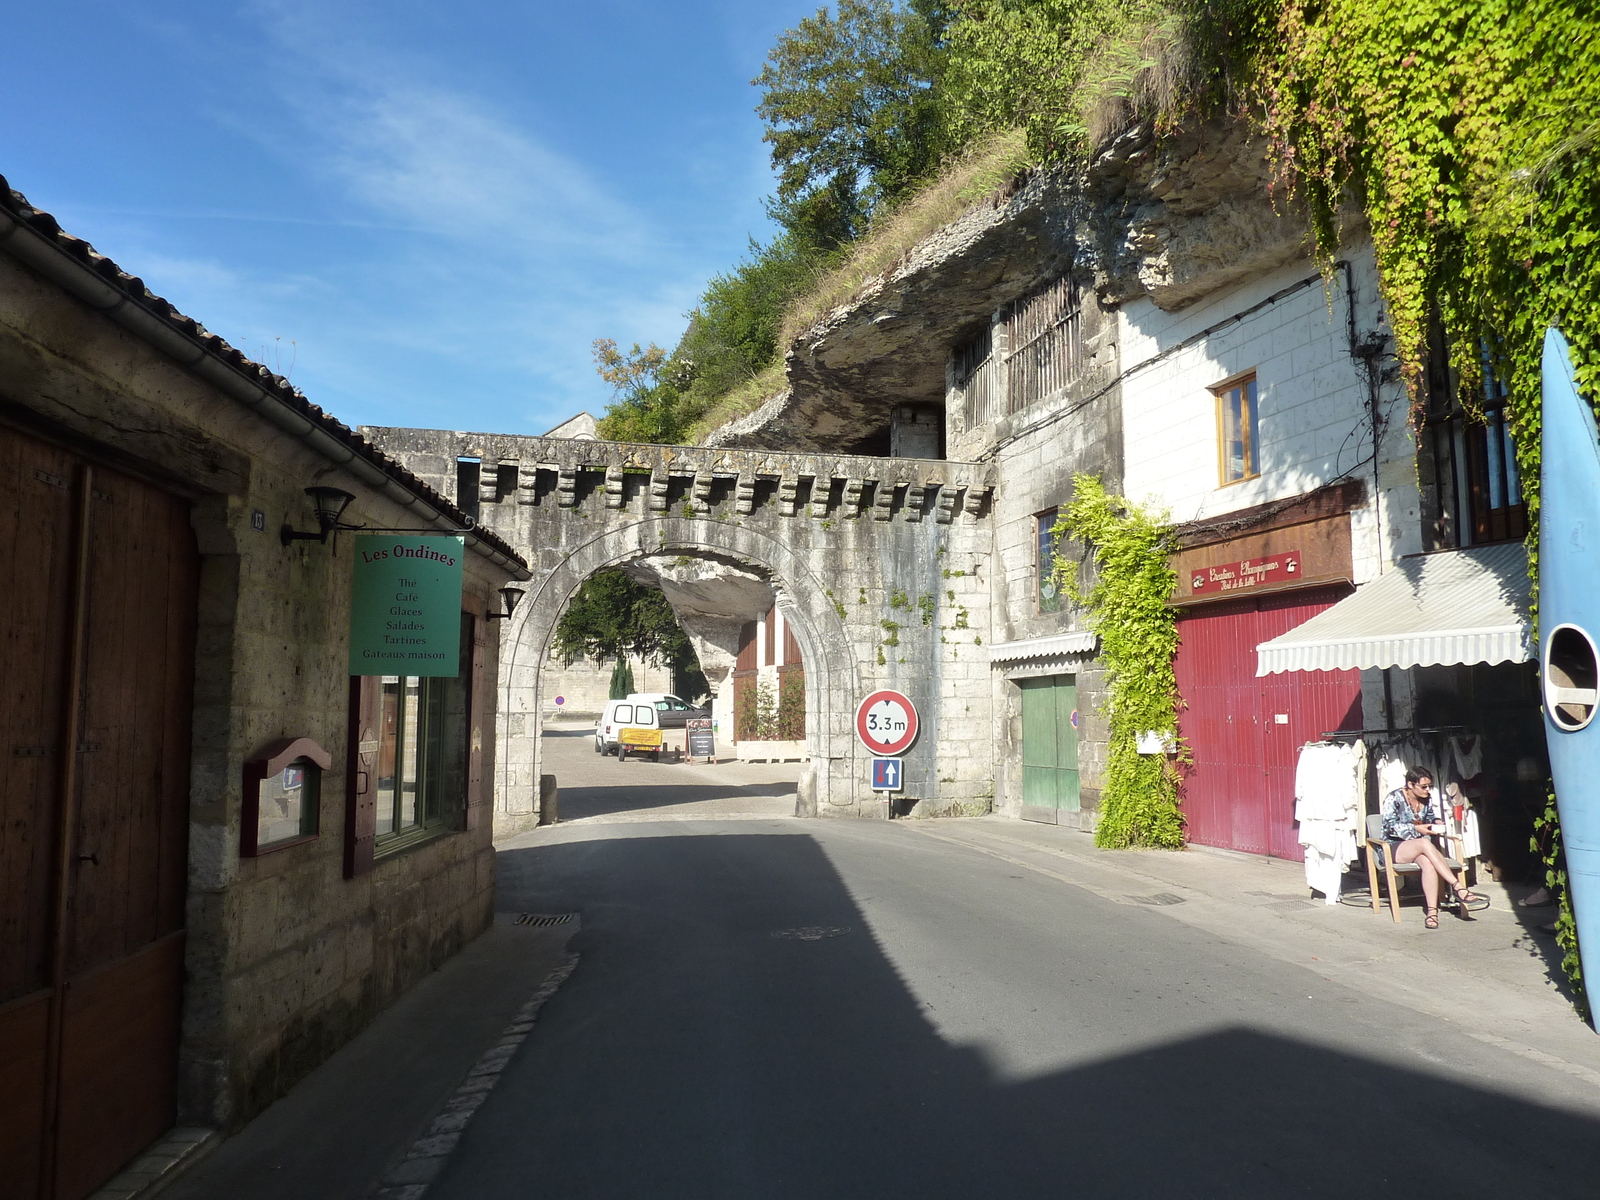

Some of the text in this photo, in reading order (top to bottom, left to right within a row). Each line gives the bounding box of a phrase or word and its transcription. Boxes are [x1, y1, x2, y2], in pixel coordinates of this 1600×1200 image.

[362, 544, 456, 567] Les Ondines
[389, 606, 423, 616] Glaces
[386, 621, 425, 631] Salades
[383, 635, 427, 645] Tartines
[362, 649, 445, 660] Gâteaux maison
